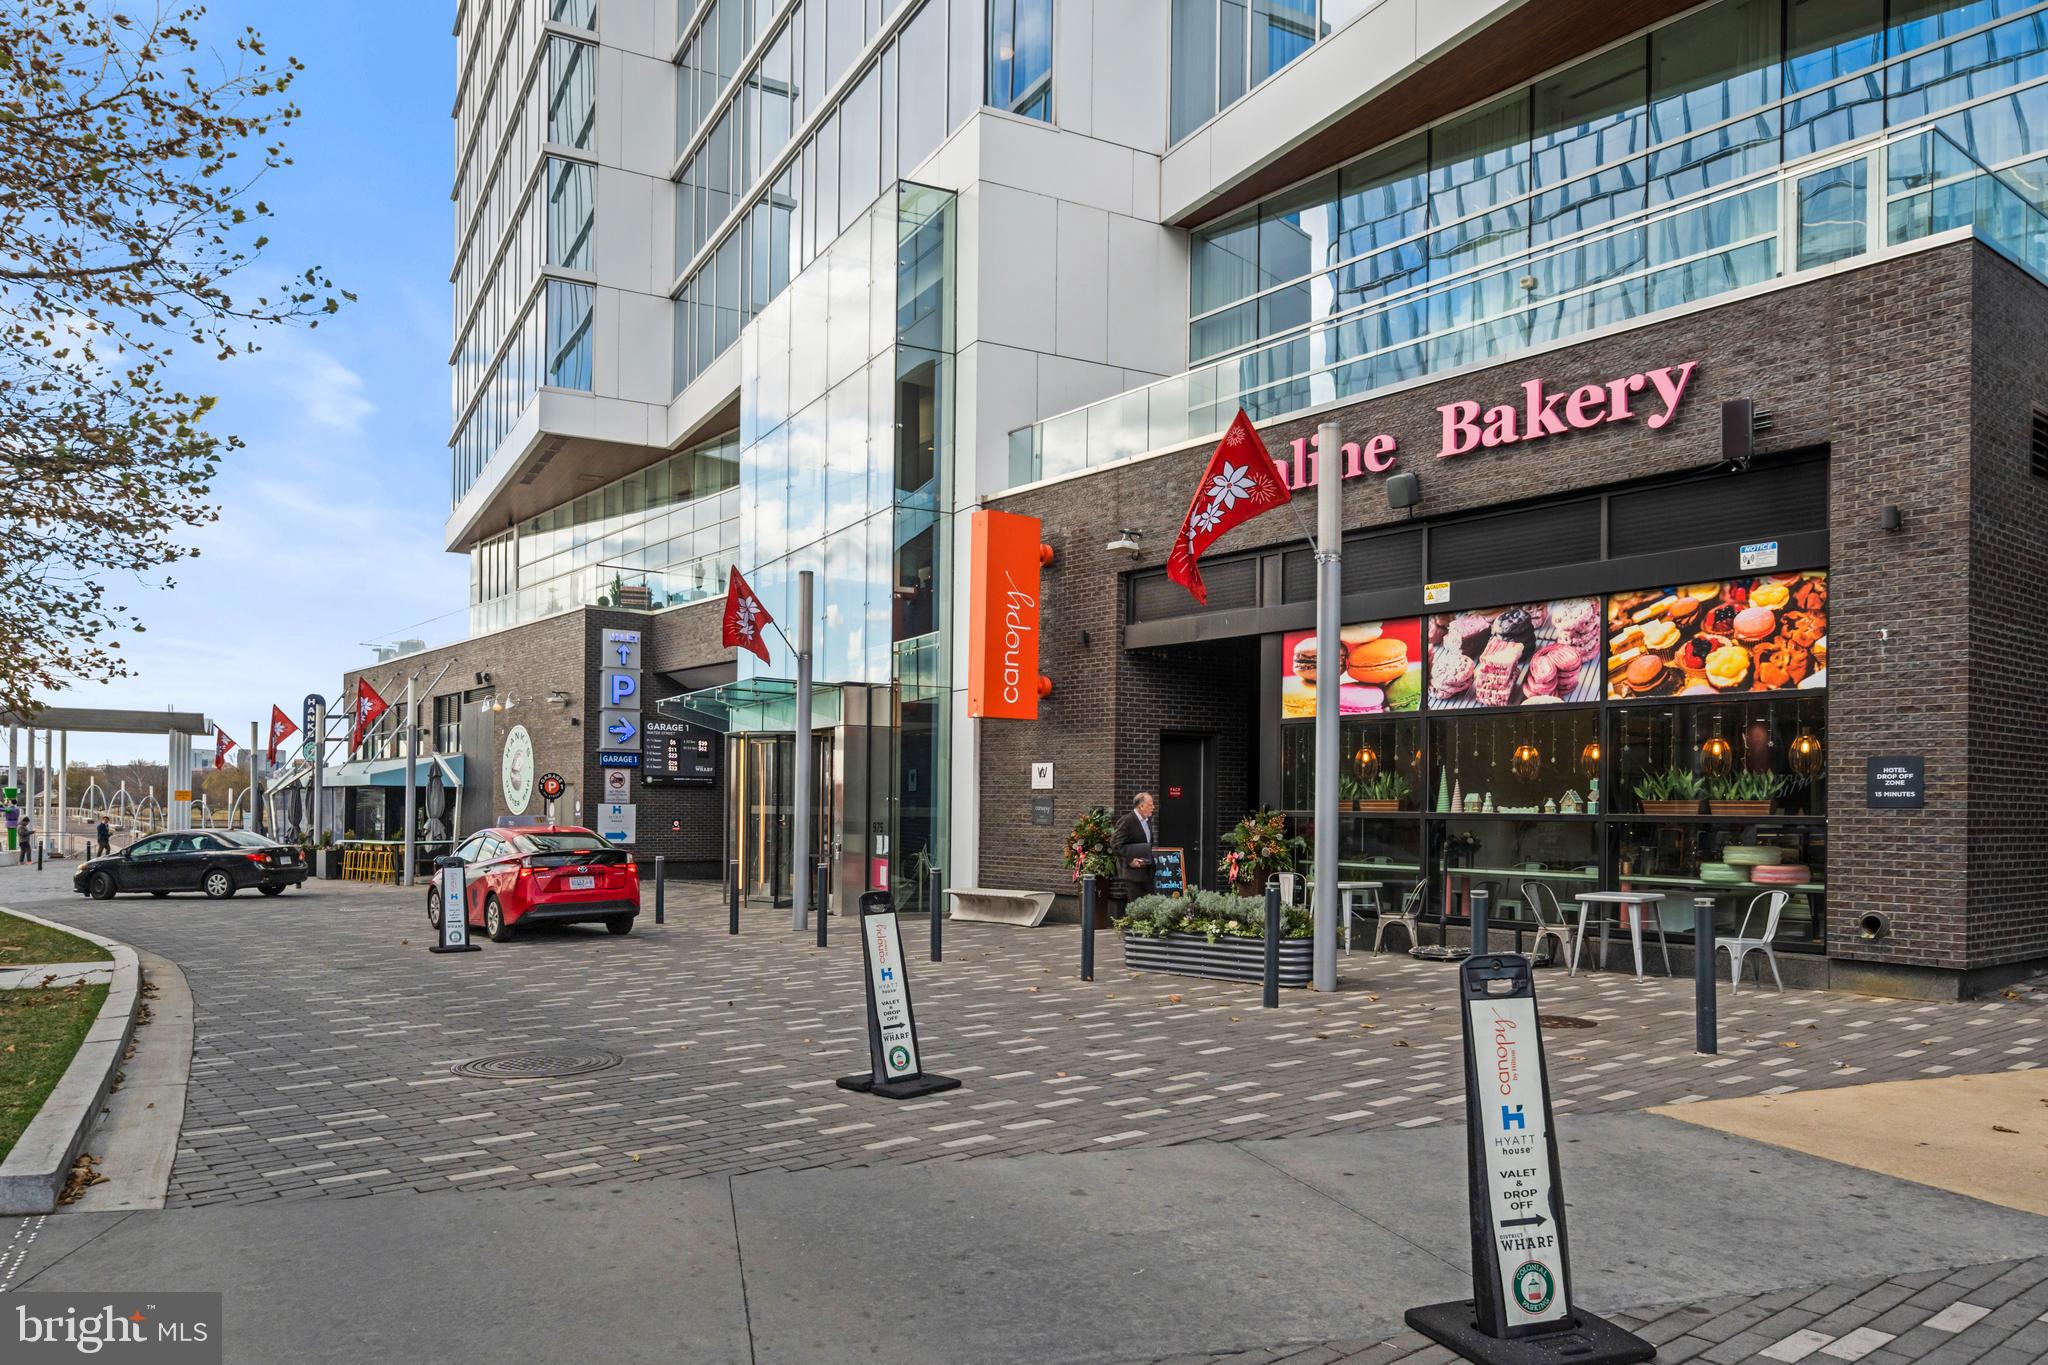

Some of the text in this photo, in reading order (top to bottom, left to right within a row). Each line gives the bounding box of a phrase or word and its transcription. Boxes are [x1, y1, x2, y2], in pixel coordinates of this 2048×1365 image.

[1436, 360, 1699, 459] Bakery
[1744, 543, 1771, 552] NOTICE
[1003, 570, 1035, 703] canopy
[611, 674, 636, 704] P
[647, 722, 683, 732] GARAGE
[548, 781, 557, 791] P
[872, 822, 884, 833] 975
[883, 1032, 910, 1042] WHARF
[1491, 1007, 1517, 1096] canopy
[1512, 1072, 1519, 1081] by
[1494, 1134, 1536, 1147] HYATT
[1502, 1146, 1531, 1155] house
[1499, 1168, 1537, 1179] VALET
[1515, 1179, 1523, 1187] &
[1503, 1189, 1538, 1200] DROP
[1510, 1200, 1533, 1211] OFF
[1500, 1235, 1554, 1252] WHARF
[1516, 1264, 1548, 1281] COLONIAL
[1521, 1297, 1550, 1312] PARKING
